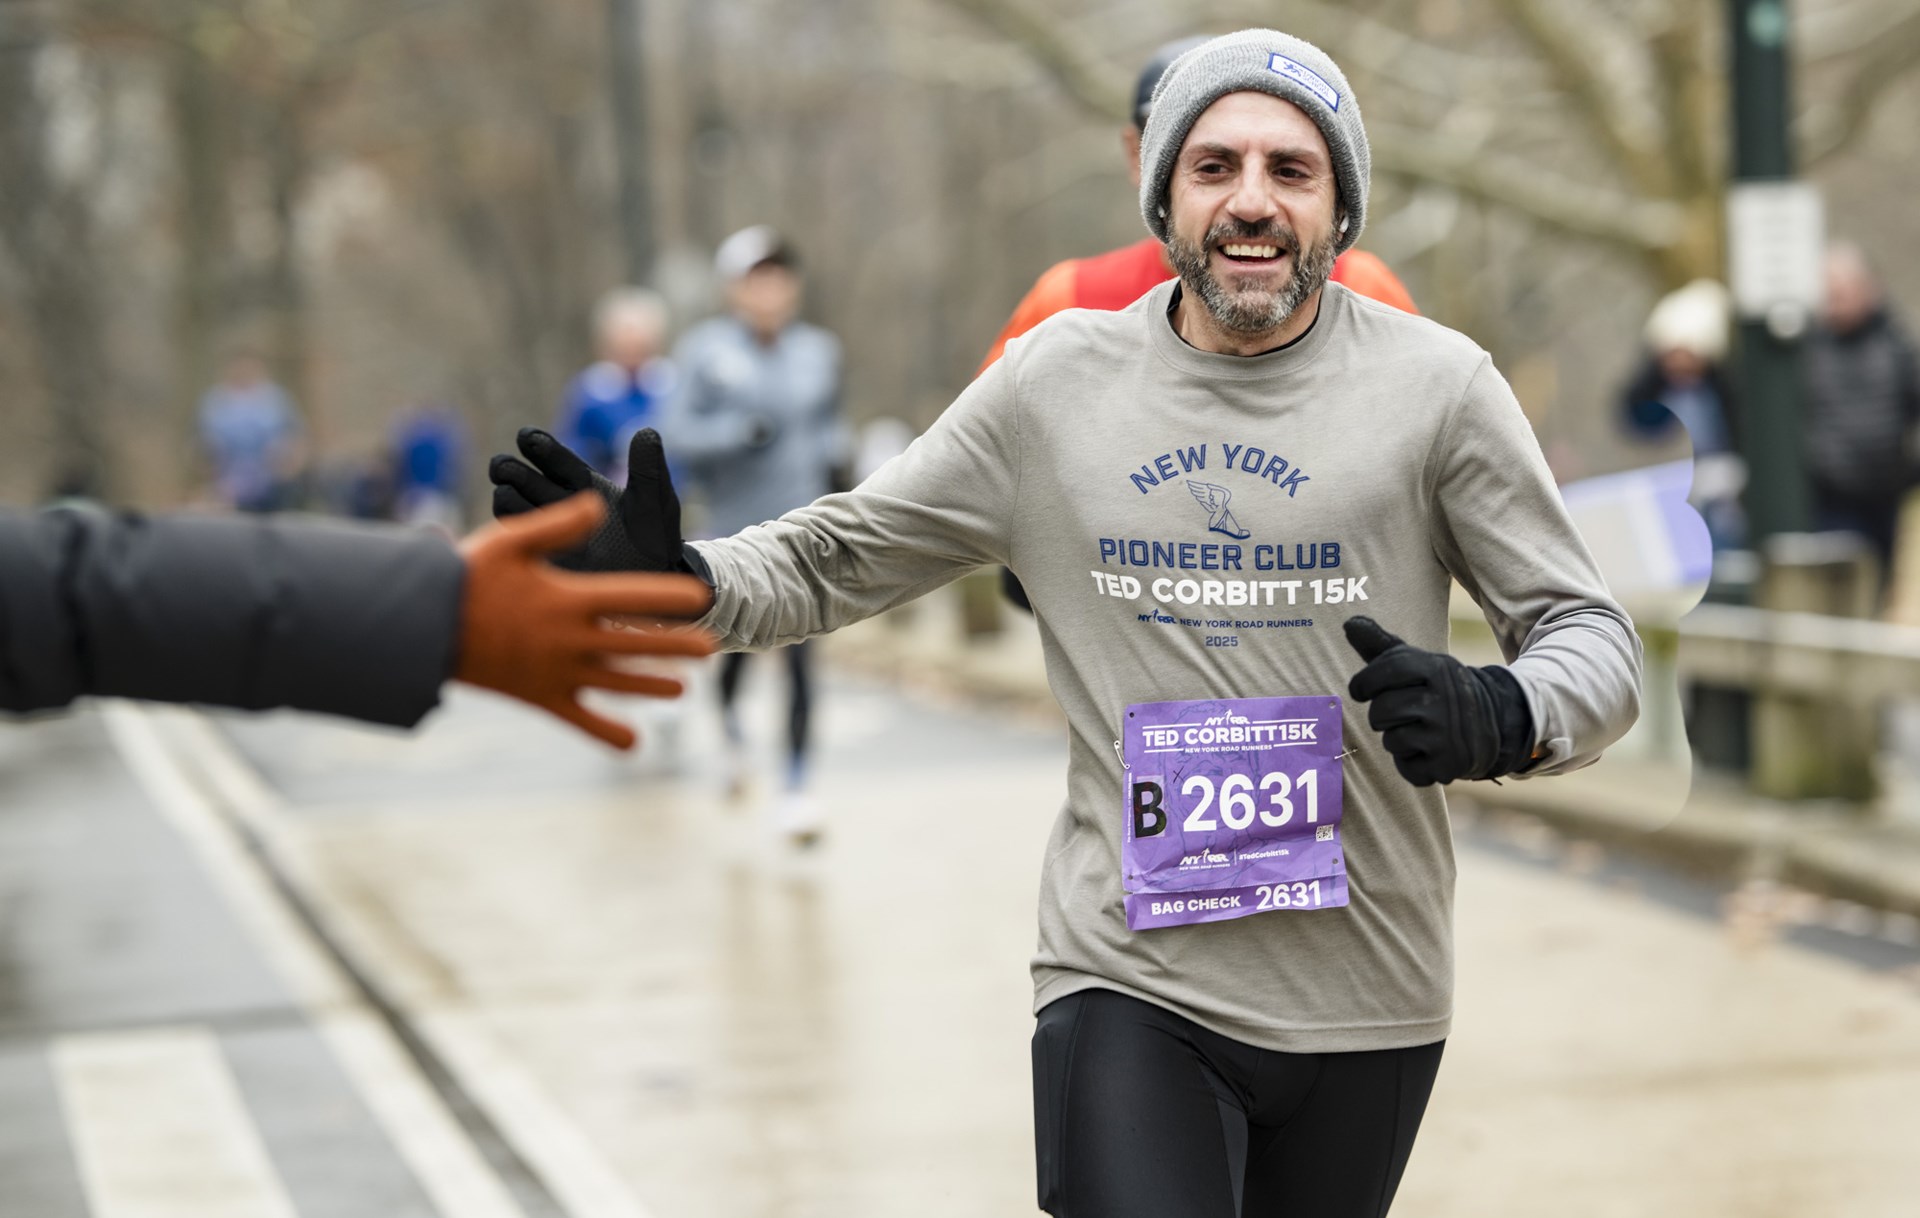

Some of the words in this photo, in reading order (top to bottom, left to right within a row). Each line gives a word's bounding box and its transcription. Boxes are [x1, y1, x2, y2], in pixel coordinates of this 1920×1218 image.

[1129, 443, 1207, 495] NEW
[1222, 443, 1311, 498] YORK
[1099, 538, 1242, 571] PIONEER
[1254, 542, 1341, 571] CLUB
[1090, 570, 1142, 600] TED
[1151, 577, 1303, 606] CORBITT
[1309, 575, 1369, 605] 15K
[1180, 618, 1202, 628] NEW
[1205, 620, 1232, 628] YORK
[1235, 621, 1264, 629] ROAD
[1266, 619, 1313, 628] RUNNERS
[1206, 636, 1238, 647] 2025
[1142, 729, 1179, 747] TED
[1184, 725, 1278, 745] CORBITT
[1278, 723, 1318, 741] 15K
[1132, 781, 1167, 838] B
[1181, 769, 1319, 832] 2631
[1239, 849, 1290, 860] #TedCorbitt15k
[1151, 899, 1185, 916] BAG
[1187, 895, 1241, 911] CHECK
[1255, 880, 1322, 911] 2631
